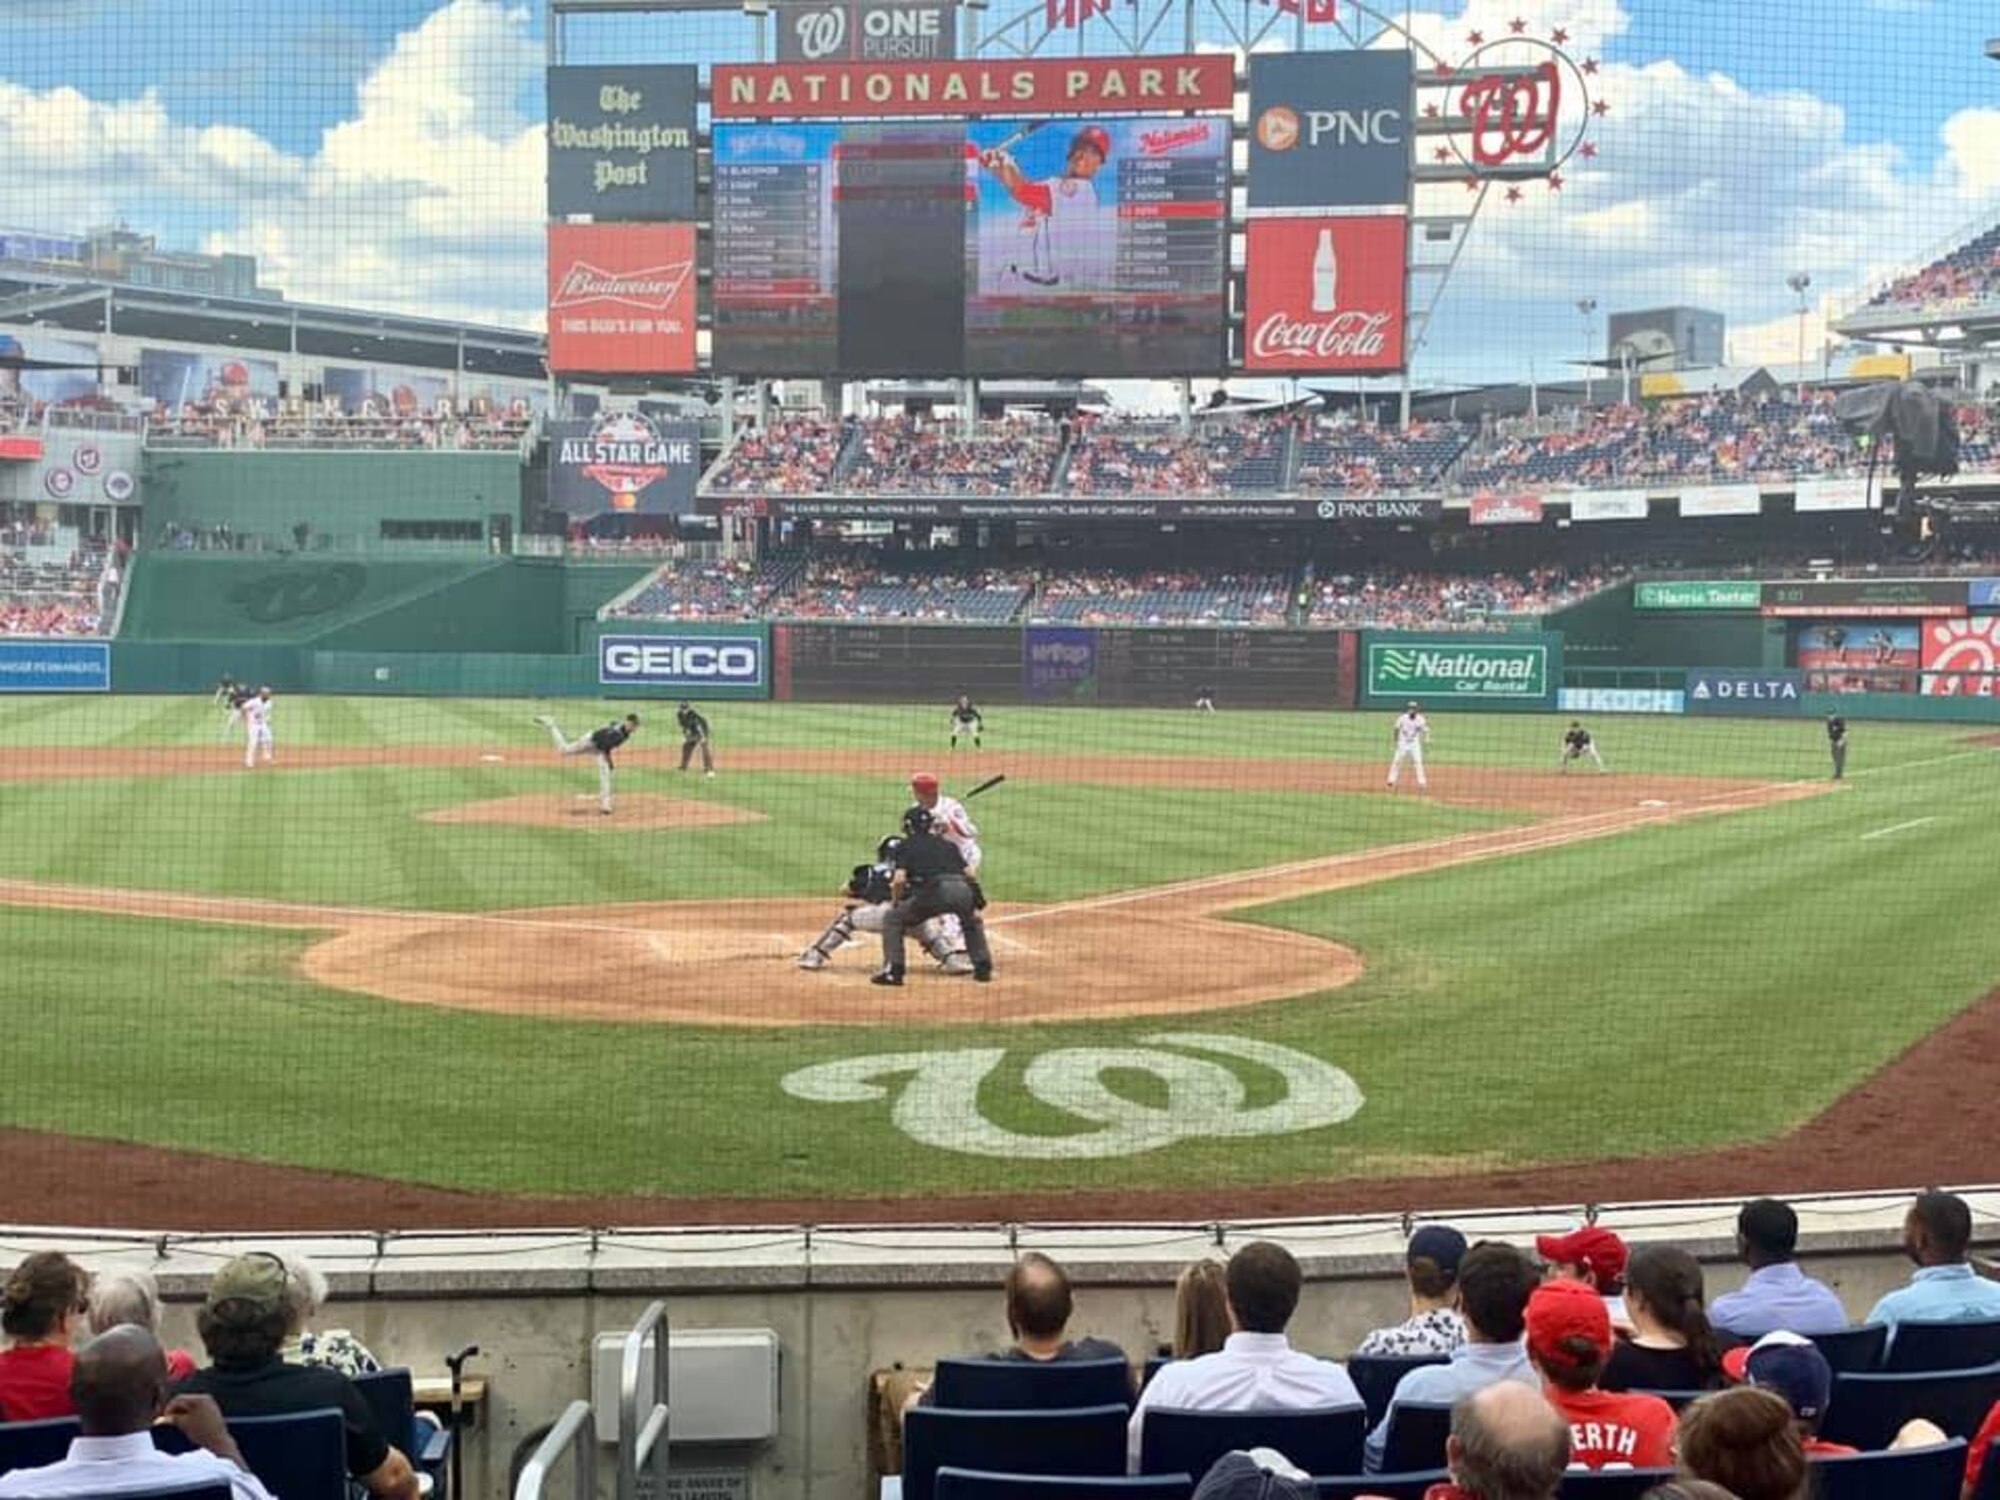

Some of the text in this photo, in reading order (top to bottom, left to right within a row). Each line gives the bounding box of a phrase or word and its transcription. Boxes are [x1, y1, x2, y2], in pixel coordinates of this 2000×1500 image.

[863, 9, 940, 36] ONE
[864, 36, 938, 59] PURSUIT
[731, 68, 1201, 103] NATIONALS PARK
[599, 84, 642, 115] The
[553, 116, 690, 153] Washington
[1304, 109, 1400, 146] PNC
[593, 159, 649, 192] Post
[565, 272, 677, 297] Budweiser
[562, 318, 684, 333] THIS BUD'S FOR YOU.
[1253, 311, 1392, 357] Coca-Cola
[560, 441, 692, 463] ALL STAR GAME
[1338, 502, 1423, 518] PNC BANK
[1658, 589, 1706, 604] Harris
[605, 644, 755, 676] GEICO
[1455, 680, 1529, 692] Car Rental
[1717, 682, 1797, 698] DELTA
[1594, 688, 1675, 711] KOCH
[1570, 1423, 1637, 1455] ERTH
